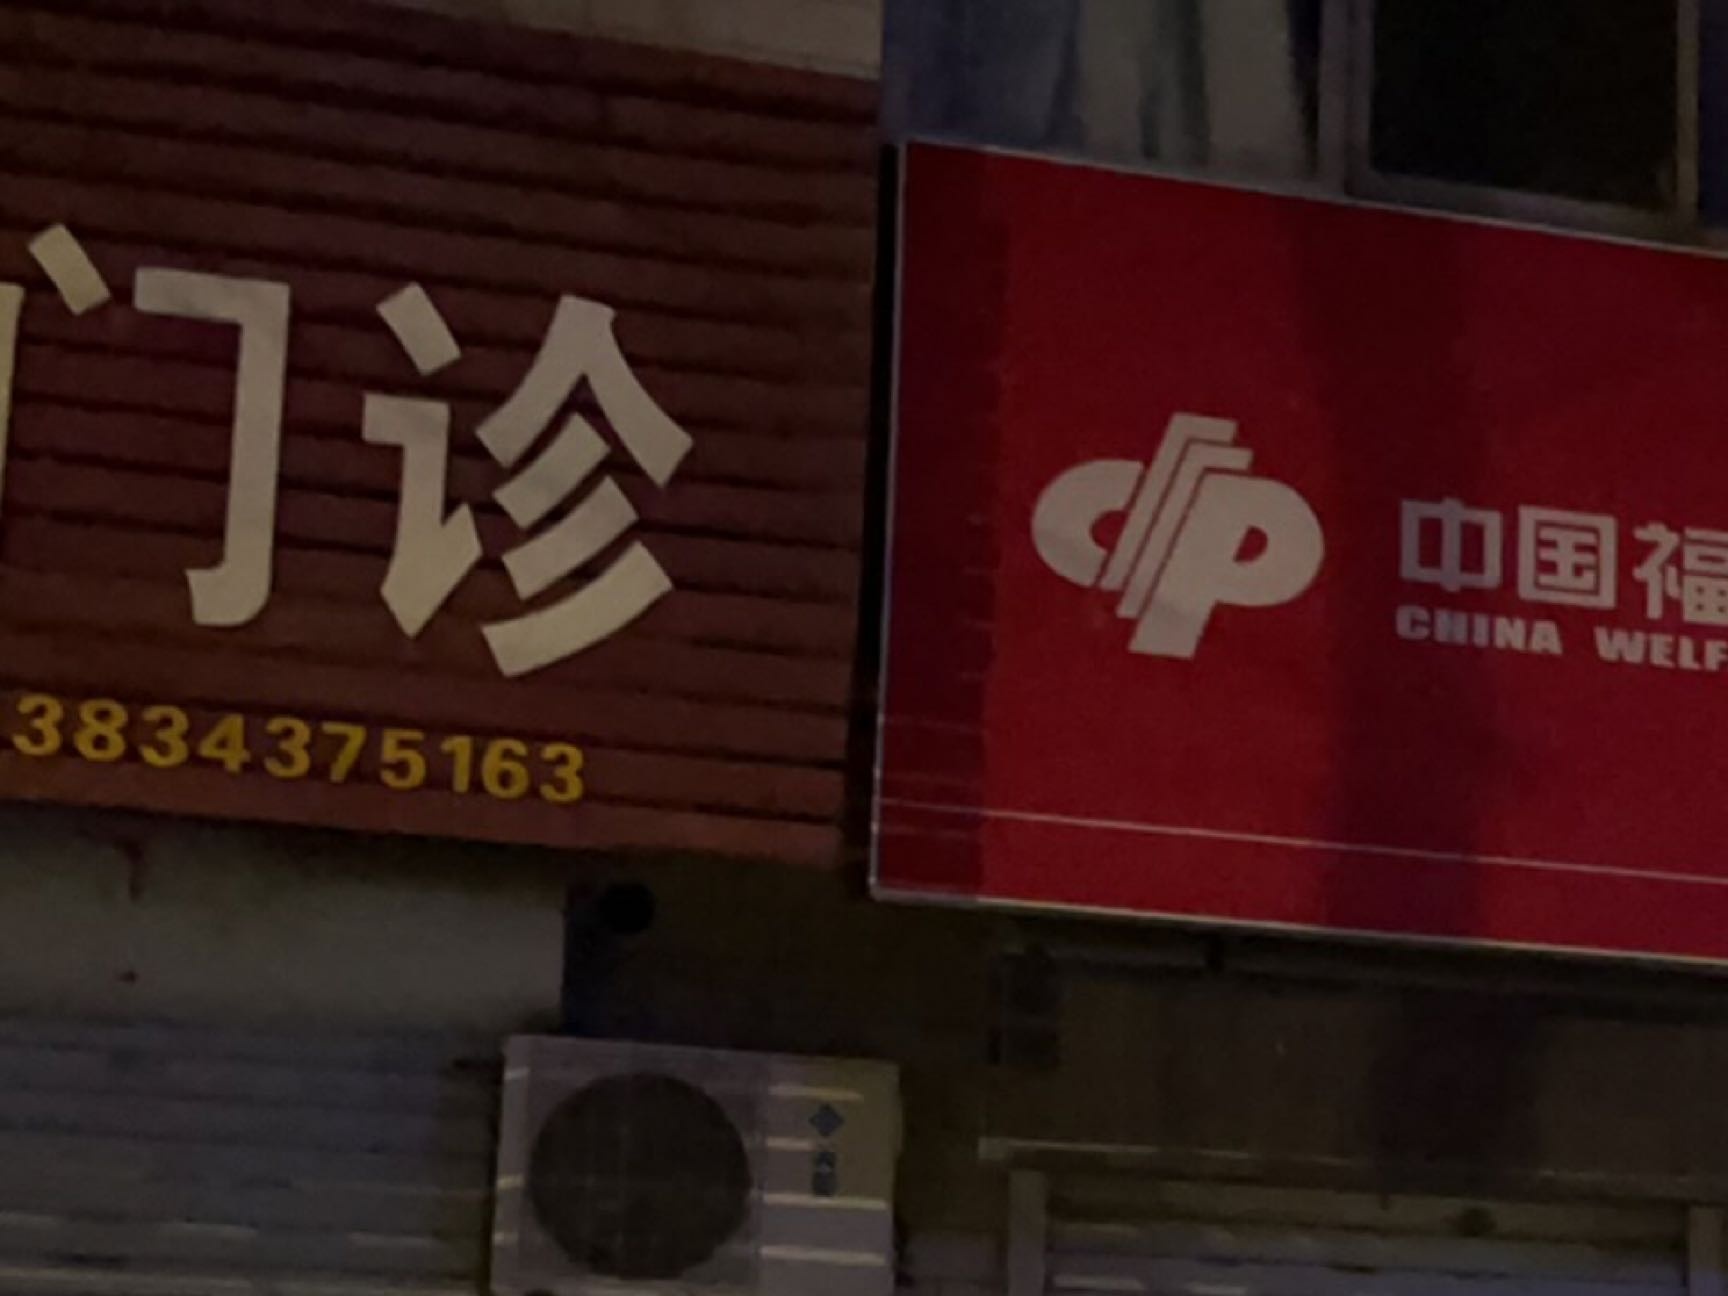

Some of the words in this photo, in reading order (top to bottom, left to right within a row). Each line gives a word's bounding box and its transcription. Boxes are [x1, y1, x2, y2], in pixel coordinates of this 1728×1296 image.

[0, 223, 694, 678] 门诊
[1394, 604, 1563, 656] CHINA
[12, 694, 587, 803] 3834375163
